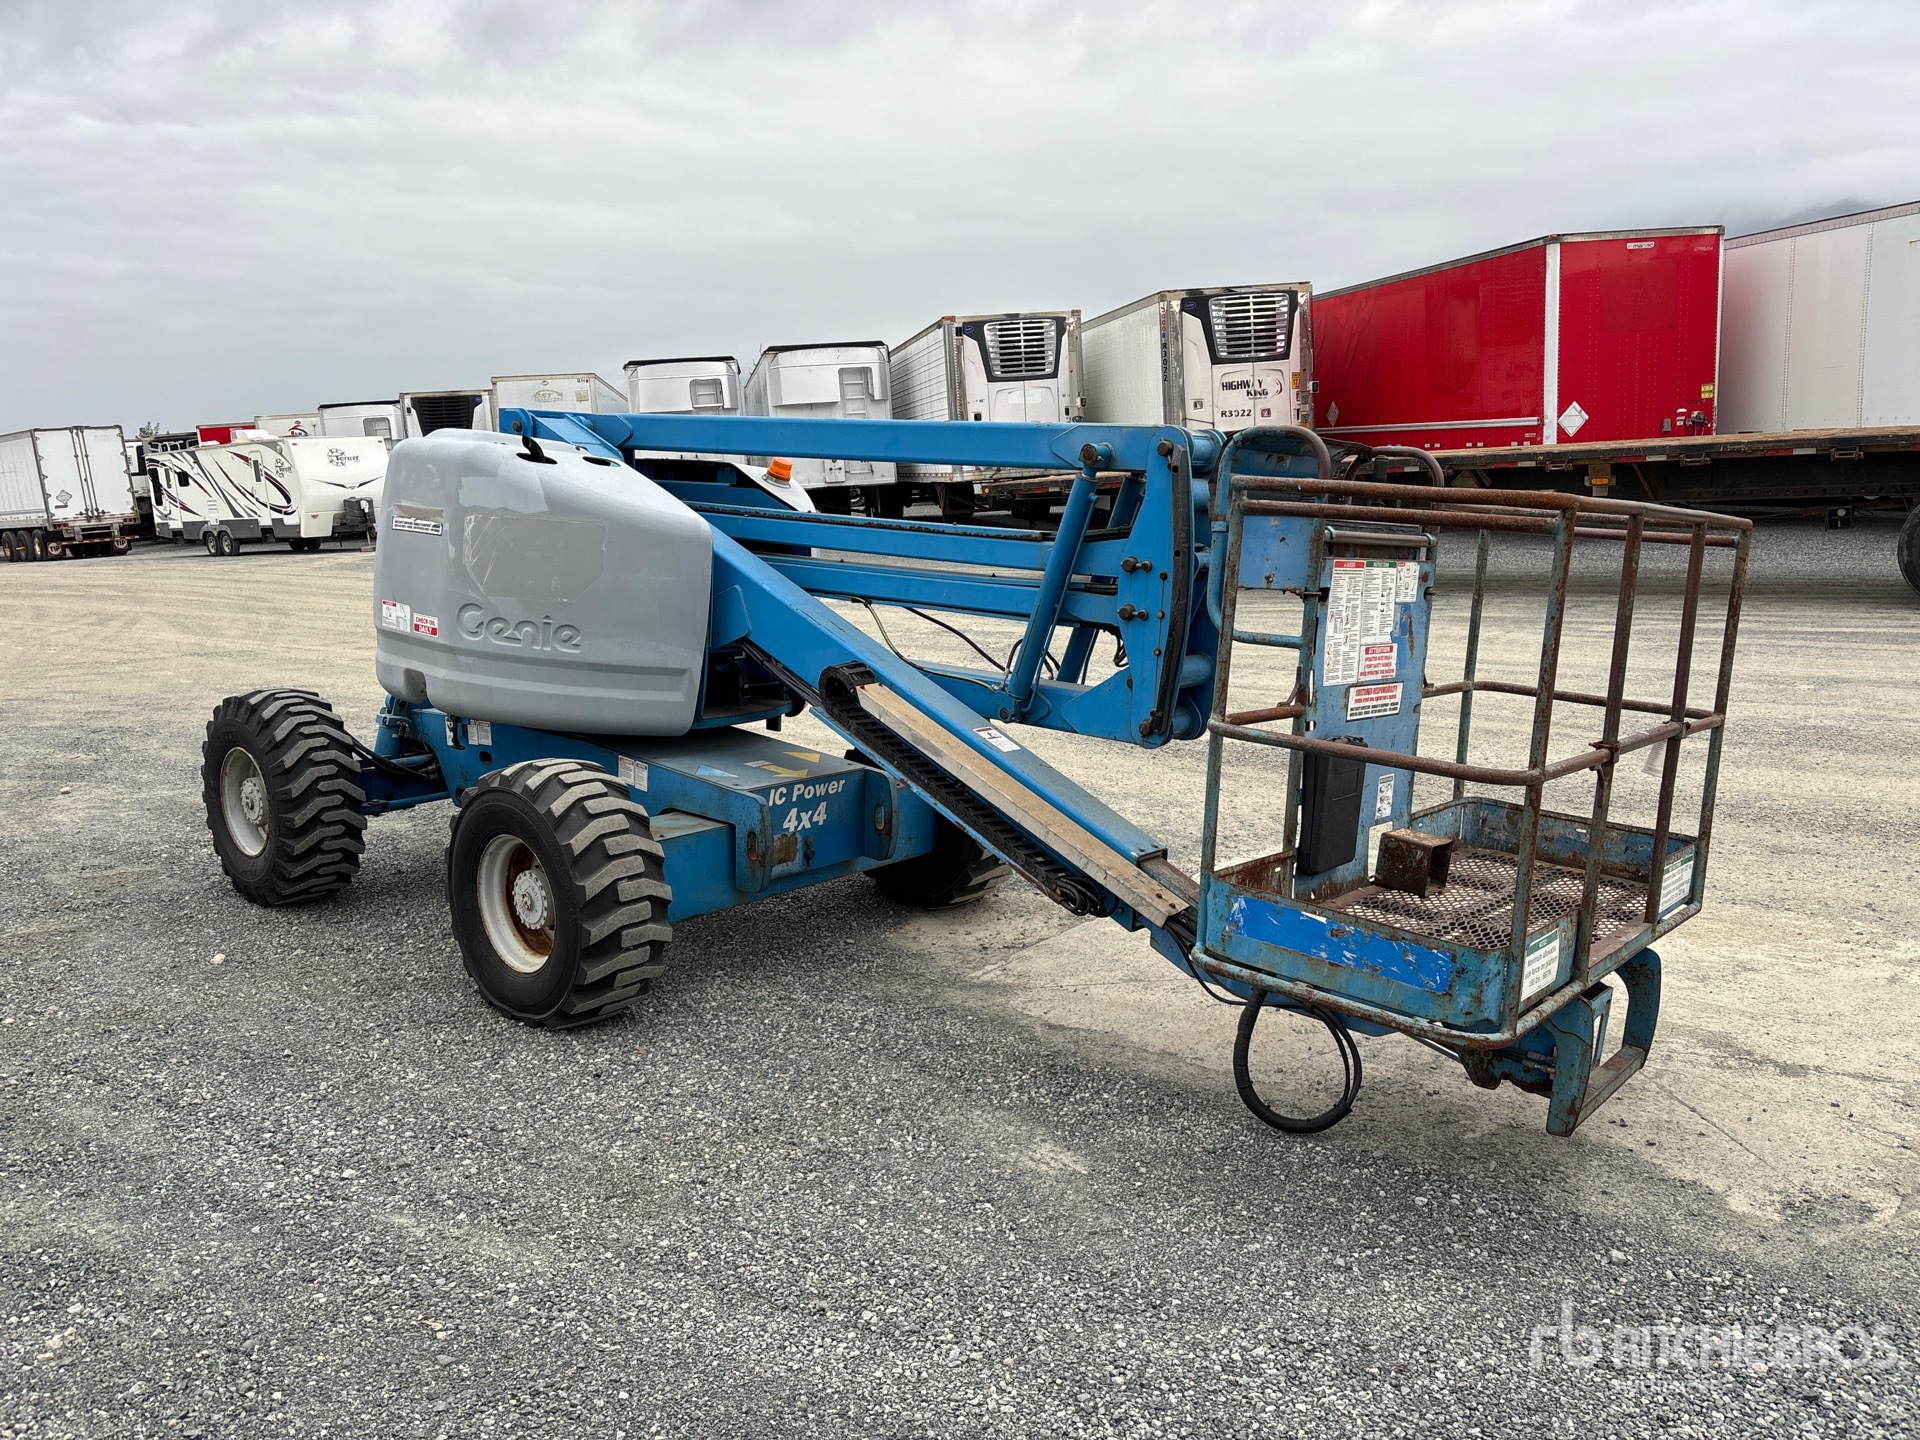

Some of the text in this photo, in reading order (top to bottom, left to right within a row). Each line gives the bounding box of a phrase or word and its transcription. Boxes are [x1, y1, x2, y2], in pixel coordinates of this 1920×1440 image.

[1246, 388, 1269, 397] KING
[49, 545, 60, 553] TIP
[415, 616, 429, 624] CHECK
[418, 624, 432, 634] DAILY
[456, 602, 581, 653] Genie
[768, 779, 846, 807] IC Power
[782, 801, 827, 832] 4x4
